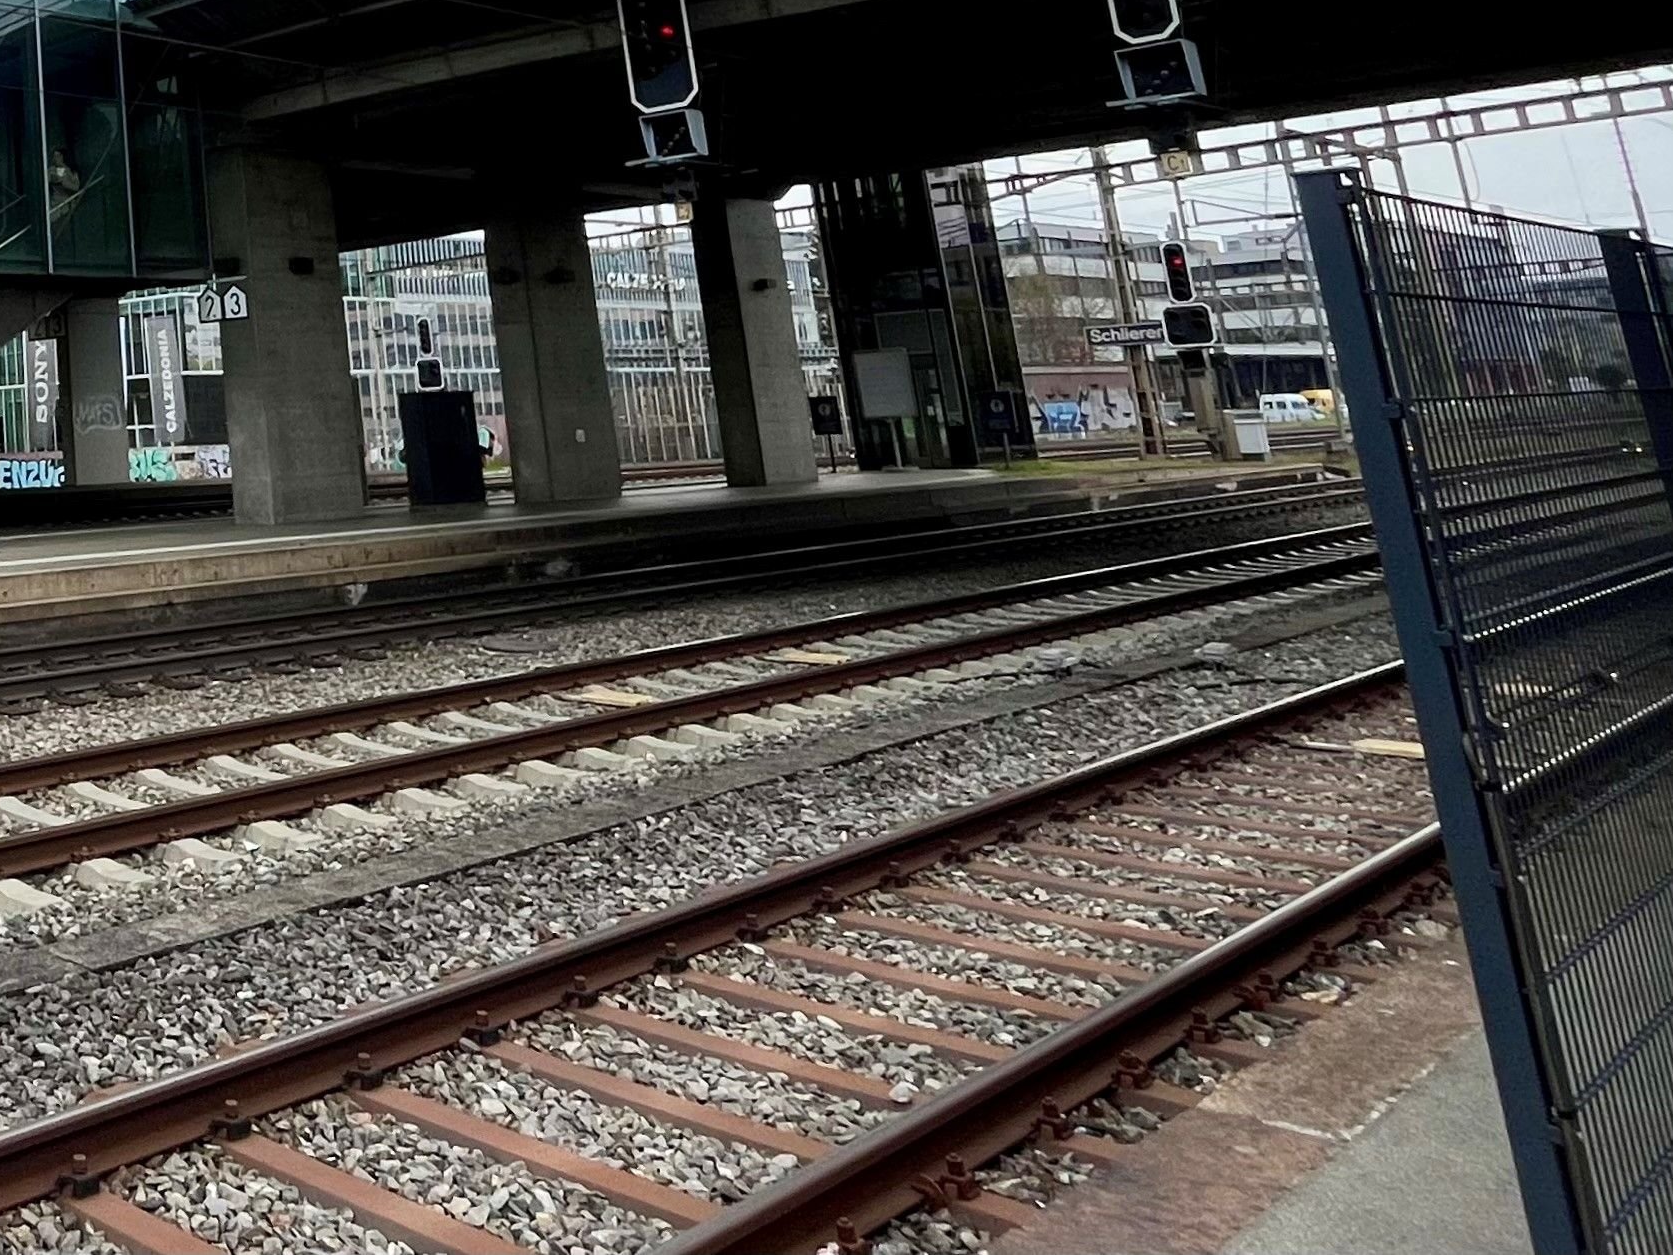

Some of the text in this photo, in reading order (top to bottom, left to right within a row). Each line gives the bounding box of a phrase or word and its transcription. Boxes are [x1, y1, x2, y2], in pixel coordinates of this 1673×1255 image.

[230, 292, 241, 316] 3
[34, 340, 50, 424] SONY
[156, 328, 177, 434] CALZEDONIA
